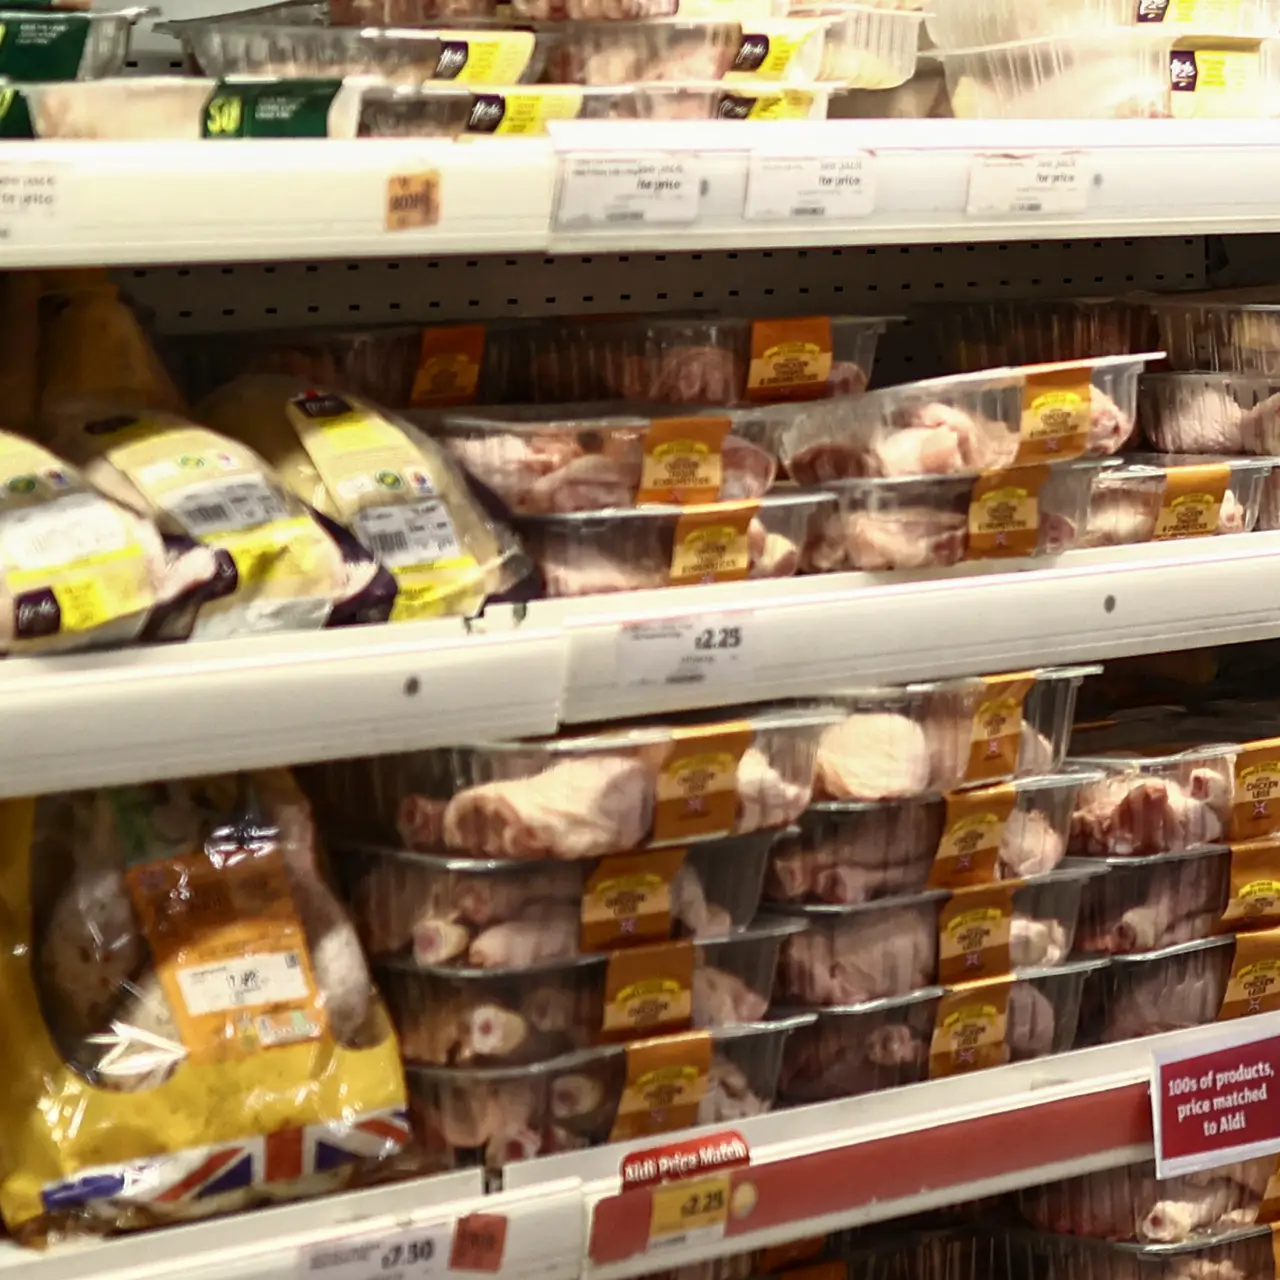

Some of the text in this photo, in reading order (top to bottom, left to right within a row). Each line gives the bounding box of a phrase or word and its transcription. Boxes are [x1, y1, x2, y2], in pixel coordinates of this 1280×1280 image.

[1247, 781, 1278, 791] CHICKEN
[1168, 1061, 1274, 1096] 100s of products,
[1177, 1083, 1267, 1122] price matched
[1204, 1111, 1246, 1136] to Aldi
[625, 1138, 748, 1181] Aldi Price Match
